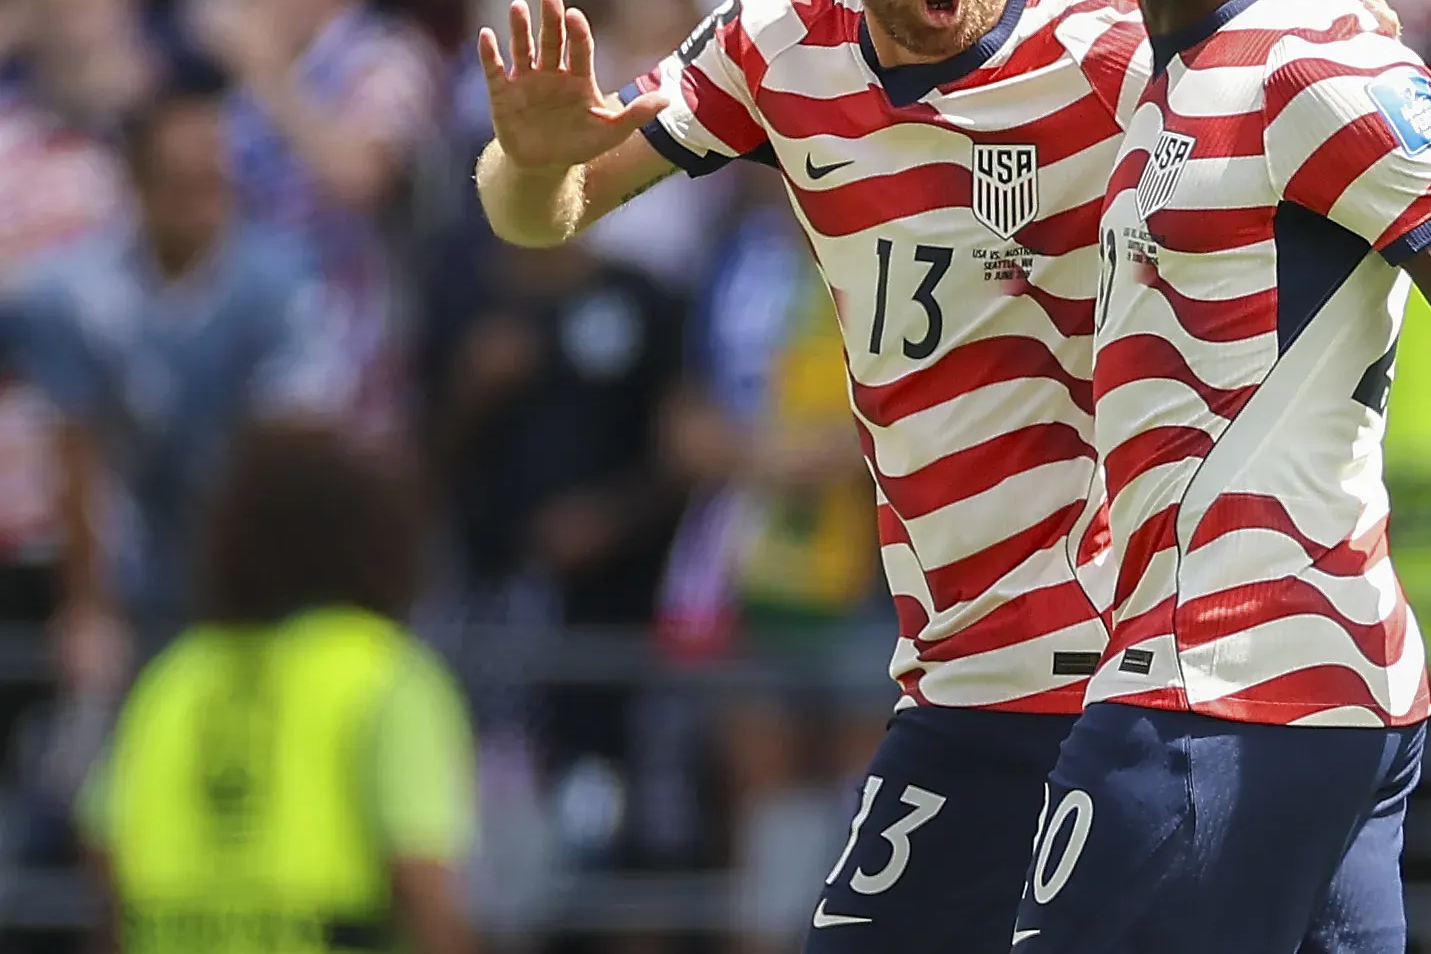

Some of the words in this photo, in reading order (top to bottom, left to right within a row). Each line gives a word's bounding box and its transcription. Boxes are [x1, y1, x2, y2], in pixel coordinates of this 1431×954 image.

[978, 149, 1032, 184] USA
[1154, 135, 1190, 170] USA
[972, 249, 987, 259] USA
[868, 237, 955, 360] 13
[824, 775, 947, 895] 13
[1022, 782, 1094, 904] 0
